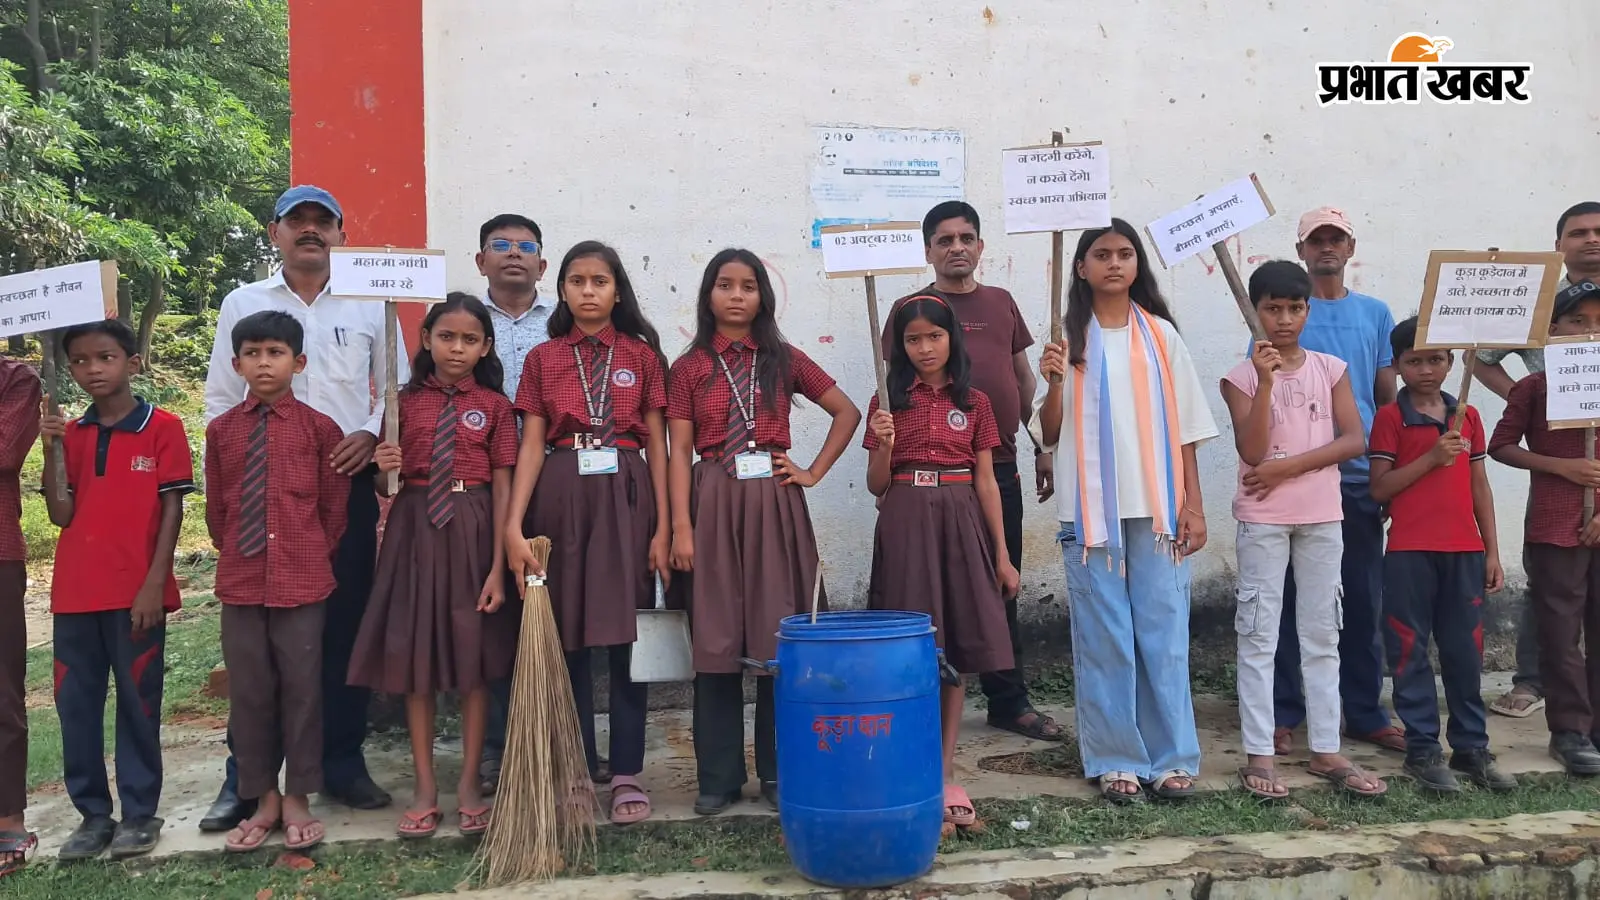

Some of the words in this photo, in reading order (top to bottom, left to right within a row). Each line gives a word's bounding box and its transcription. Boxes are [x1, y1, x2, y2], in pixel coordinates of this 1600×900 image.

[1018, 154, 1028, 163] न
[1026, 175, 1036, 184] न
[1039, 171, 1067, 184] करने
[1008, 197, 1038, 206] स्वच्छ
[1039, 194, 1065, 204] भारत
[1067, 191, 1107, 203] अभियान
[1167, 212, 1205, 235] स्वच्छता
[834, 236, 847, 246] 02
[849, 234, 888, 248] अक्टूबर
[890, 233, 913, 243] 2026
[1174, 234, 1203, 253] बीमारी
[352, 256, 396, 268] महात्मा
[398, 255, 429, 269] गांधी
[1455, 267, 1477, 281] कूड़ा
[42, 283, 51, 298] है
[55, 280, 83, 294] जीवन
[368, 279, 396, 289] अमर
[1470, 287, 1510, 297] स्वच्छता
[1512, 285, 1529, 297] की
[1438, 304, 1472, 316] मिसाल
[1473, 306, 1505, 316] कायम
[1, 315, 14, 327] का
[19, 310, 52, 325] आधार।
[1558, 362, 1580, 375] रखो
[1557, 381, 1581, 393] अच्छे
[812, 714, 857, 753] कूड़ा
